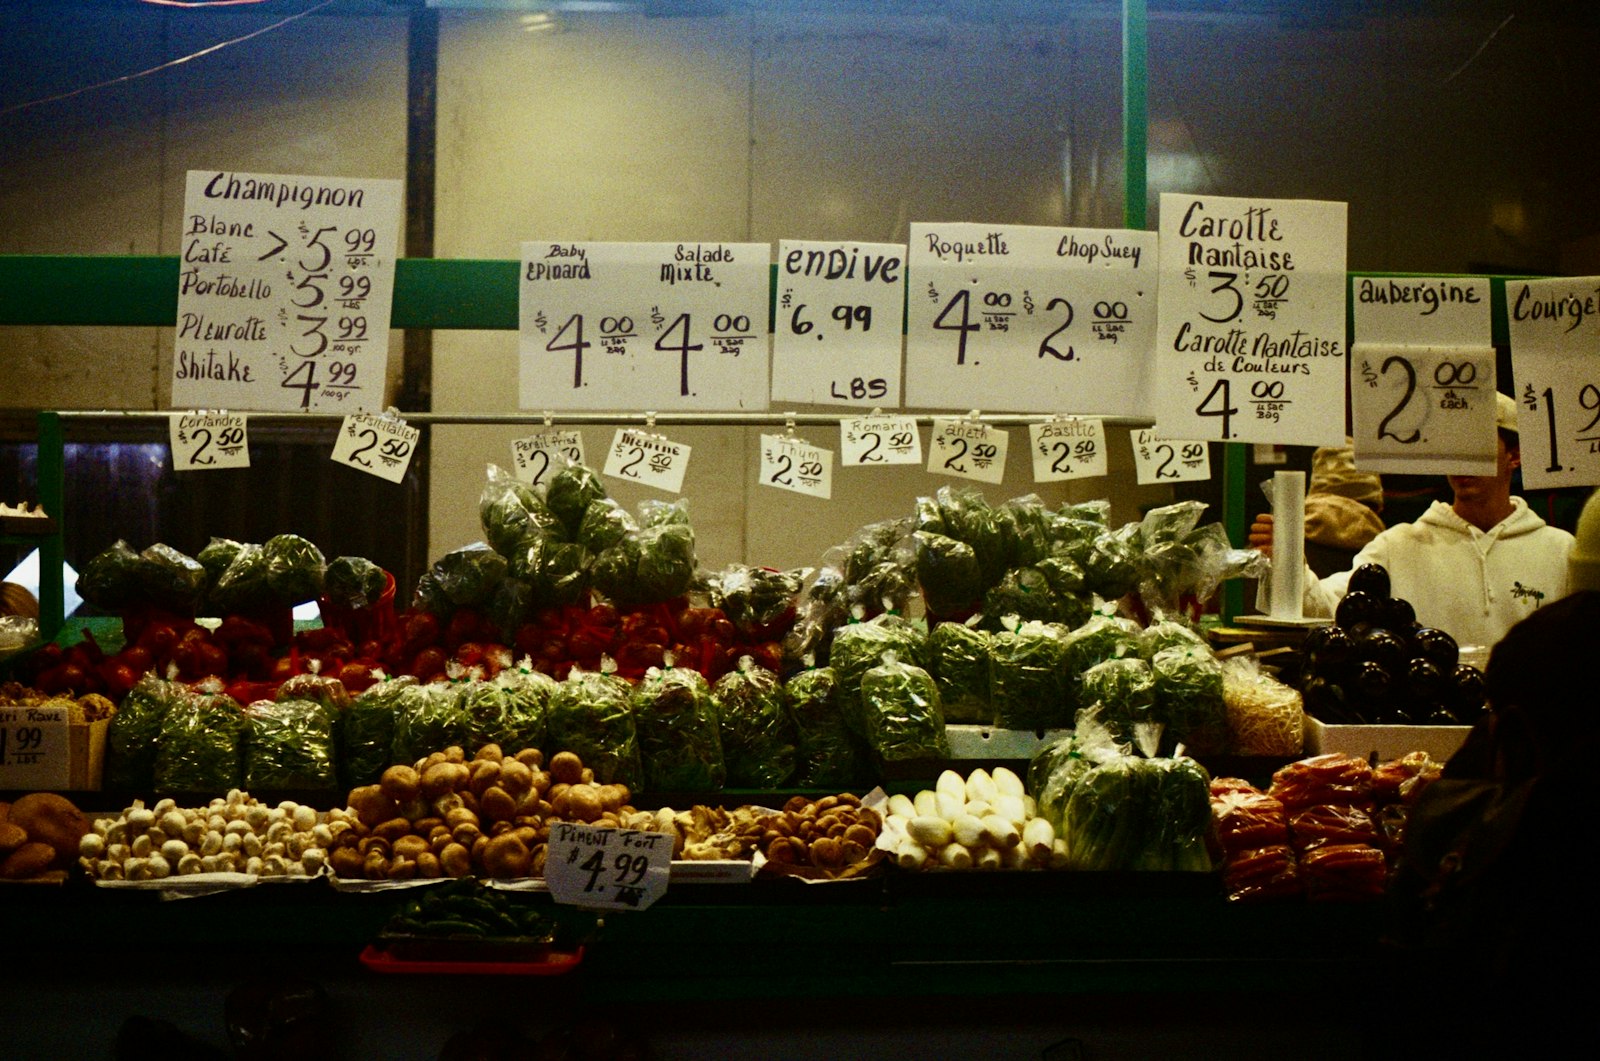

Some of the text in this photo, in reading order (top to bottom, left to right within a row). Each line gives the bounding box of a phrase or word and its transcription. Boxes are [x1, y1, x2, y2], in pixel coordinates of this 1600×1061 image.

[204, 173, 364, 209] Champignon
[186, 215, 253, 238] Blanc
[1179, 201, 1284, 243] Carotte
[544, 244, 586, 260] Baby
[675, 244, 735, 263] Salade
[924, 232, 1010, 257] Roquette
[181, 271, 271, 299] Portobello
[1513, 284, 1600, 334] Courge
[179, 313, 267, 341] Pleurotte
[1174, 322, 1247, 356] Carotte
[176, 349, 255, 383] Shitake
[1204, 356, 1311, 375] de Couleurs
[830, 376, 888, 400] LBS
[179, 415, 243, 429] Coriandre
[850, 420, 914, 432] Romarin
[1037, 421, 1096, 442] Basilic
